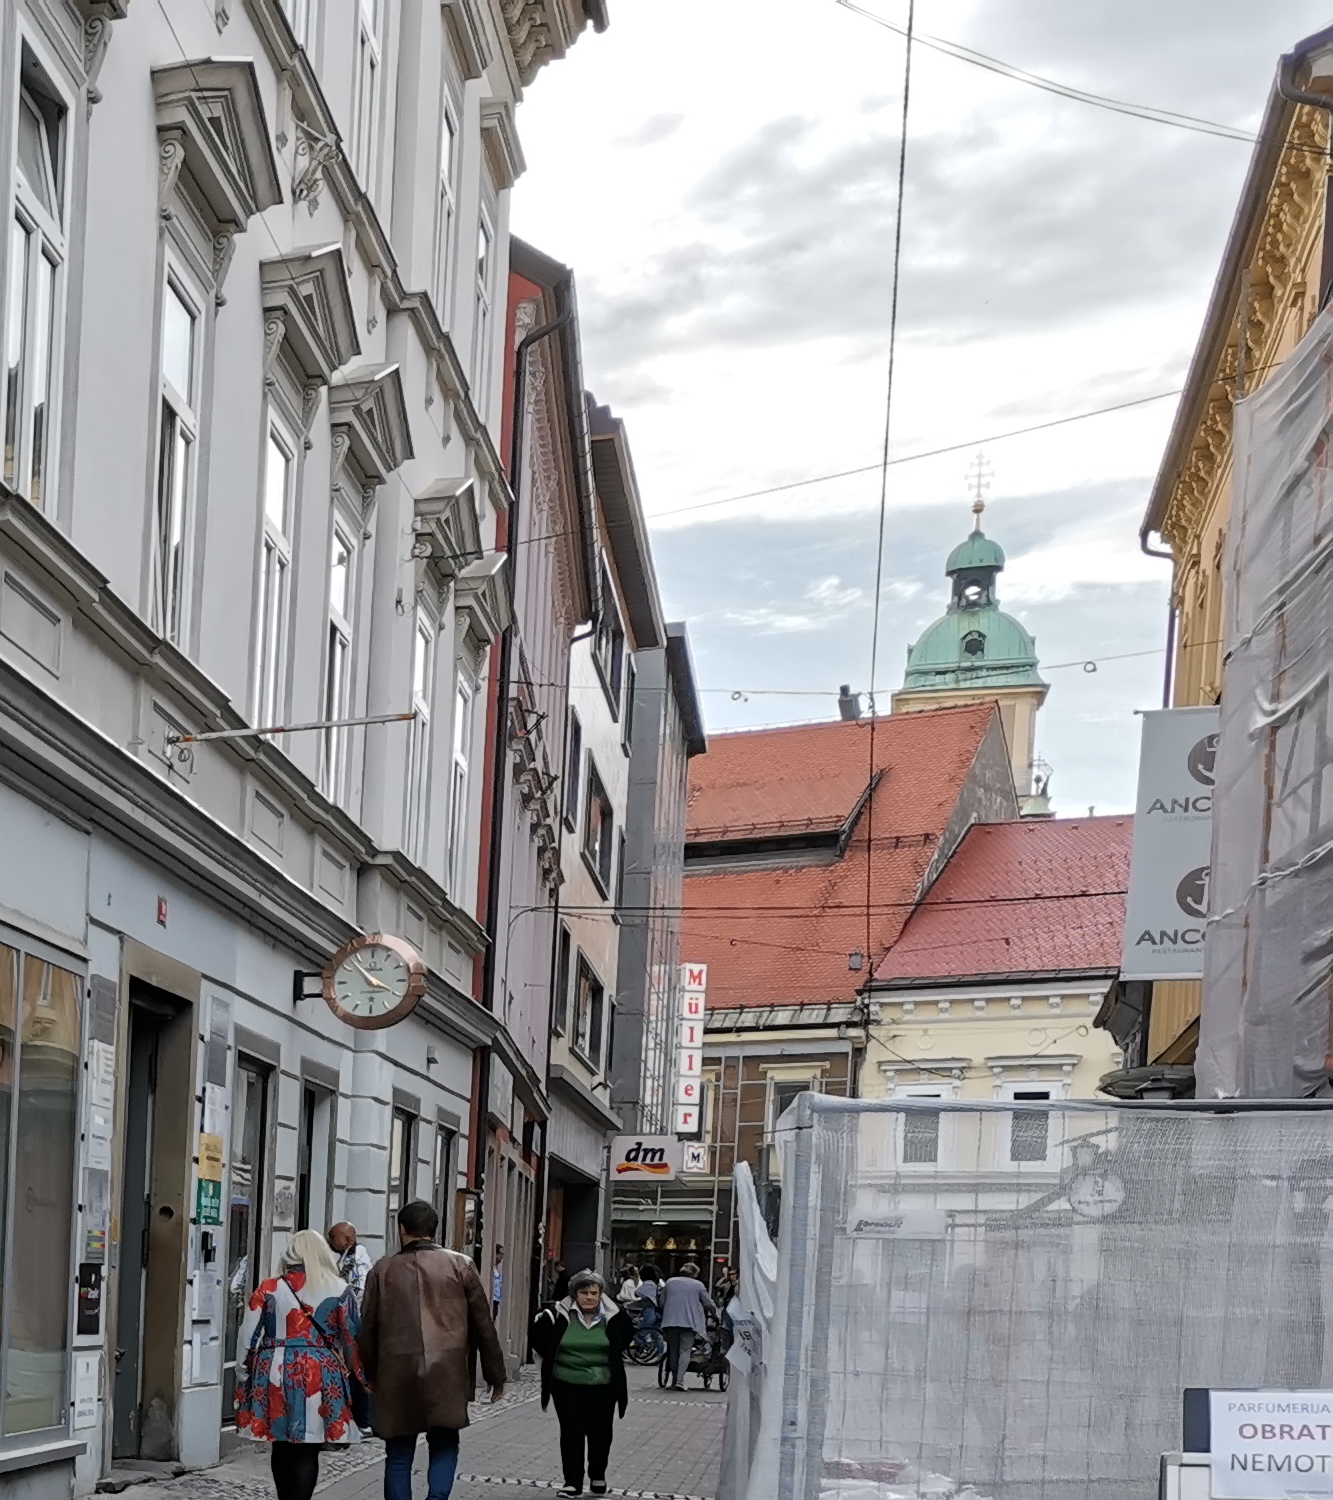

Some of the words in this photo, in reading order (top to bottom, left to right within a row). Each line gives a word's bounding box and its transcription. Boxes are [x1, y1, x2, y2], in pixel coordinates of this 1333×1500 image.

[1134, 929, 1206, 946] ANC
[681, 968, 704, 1126] Müller
[624, 1141, 666, 1164] dm
[1227, 1402, 1332, 1414] PARFUMERIJA
[1238, 1423, 1332, 1441] OBRAT
